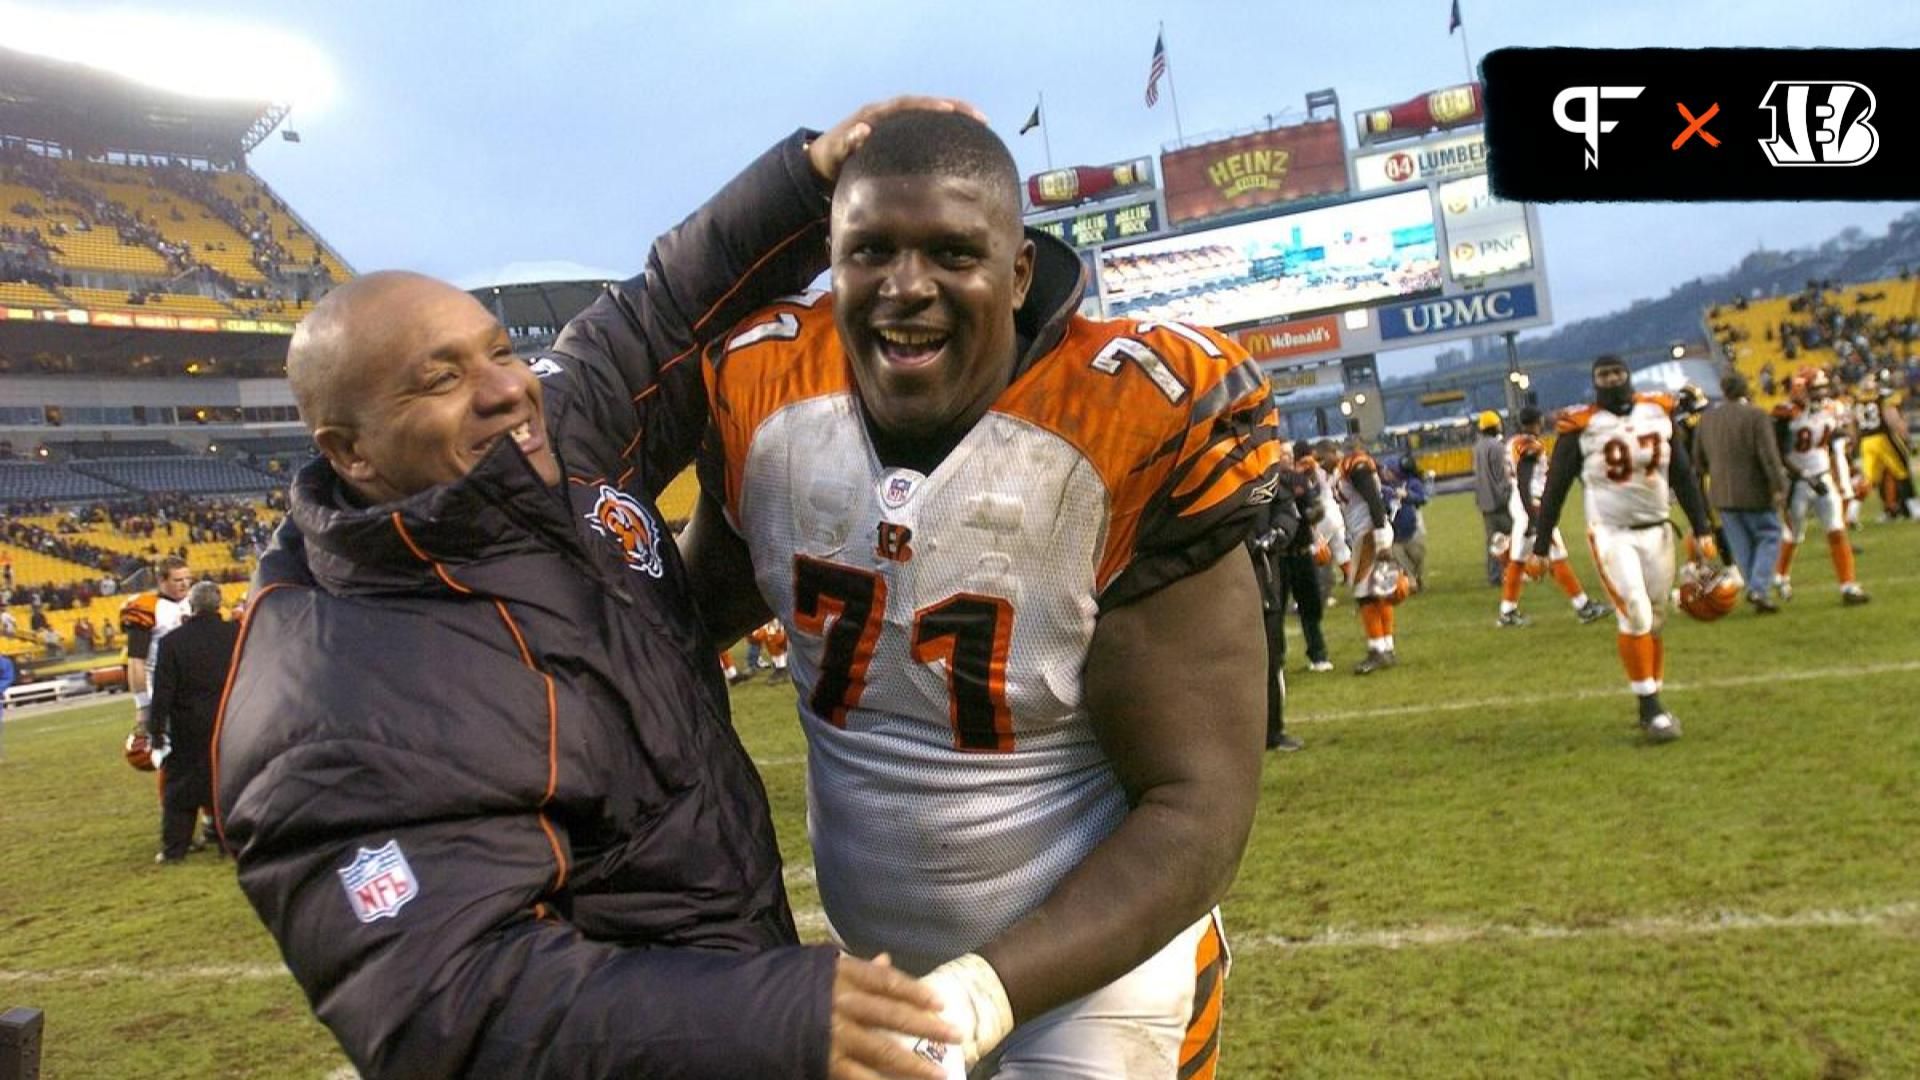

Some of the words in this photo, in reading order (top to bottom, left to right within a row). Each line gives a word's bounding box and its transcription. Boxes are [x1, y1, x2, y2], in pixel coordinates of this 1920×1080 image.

[1208, 150, 1289, 187] HEINZ
[1403, 291, 1514, 334] UPMC
[1271, 327, 1331, 349] McDonald's
[1604, 432, 1661, 485] 97
[793, 554, 1015, 754] 71
[354, 863, 411, 915] NFL
